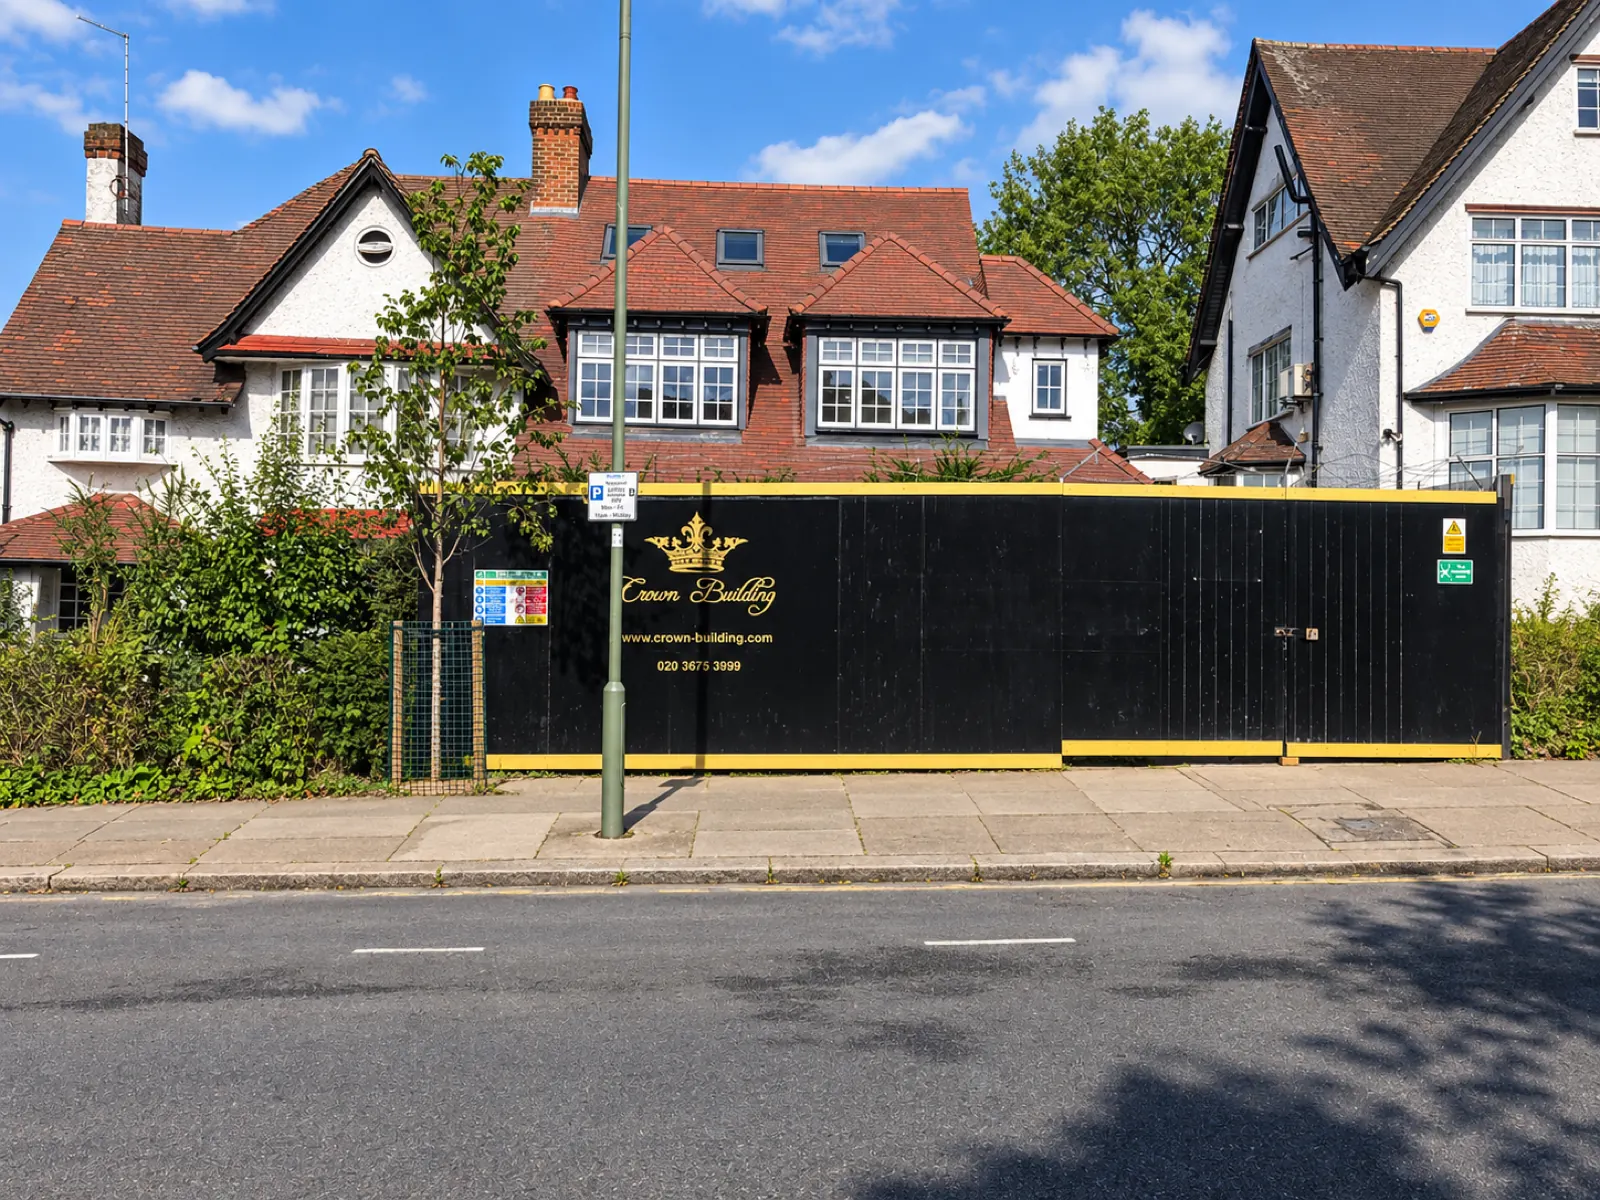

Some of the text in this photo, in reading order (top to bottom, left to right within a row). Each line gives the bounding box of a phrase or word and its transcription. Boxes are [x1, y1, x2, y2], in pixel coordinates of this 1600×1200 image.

[622, 576, 777, 617] Crown Building
[622, 632, 773, 646] www.crown-building.com
[657, 661, 742, 671] 020 3675 3999
